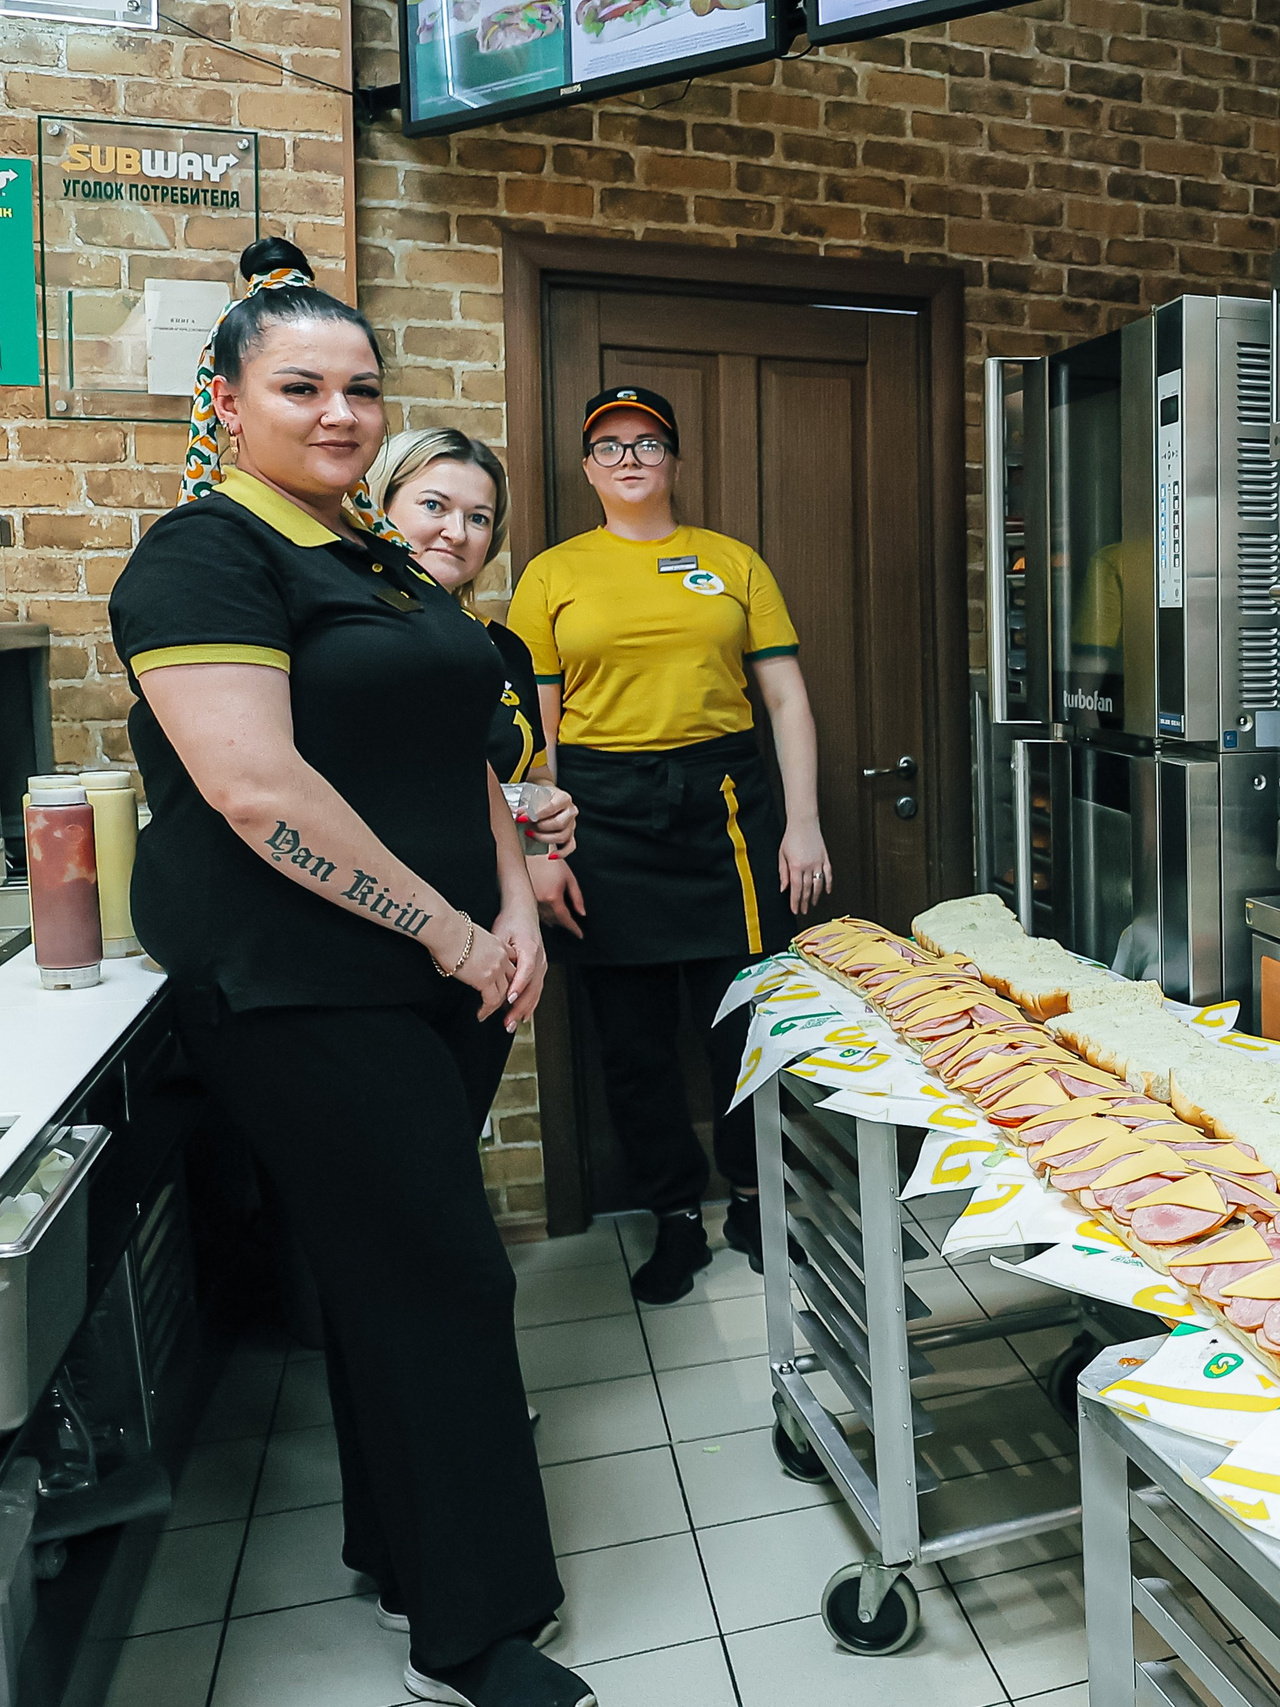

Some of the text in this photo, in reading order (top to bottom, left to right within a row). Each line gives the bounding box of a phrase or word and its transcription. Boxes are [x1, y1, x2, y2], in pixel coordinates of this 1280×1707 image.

[61, 143, 240, 182] SUBWAY
[62, 179, 240, 208] УГОЛОК ПОТРЕБИТЕЛЯ
[1063, 688, 1113, 713] turbofan
[340, 870, 433, 937] Kirill
